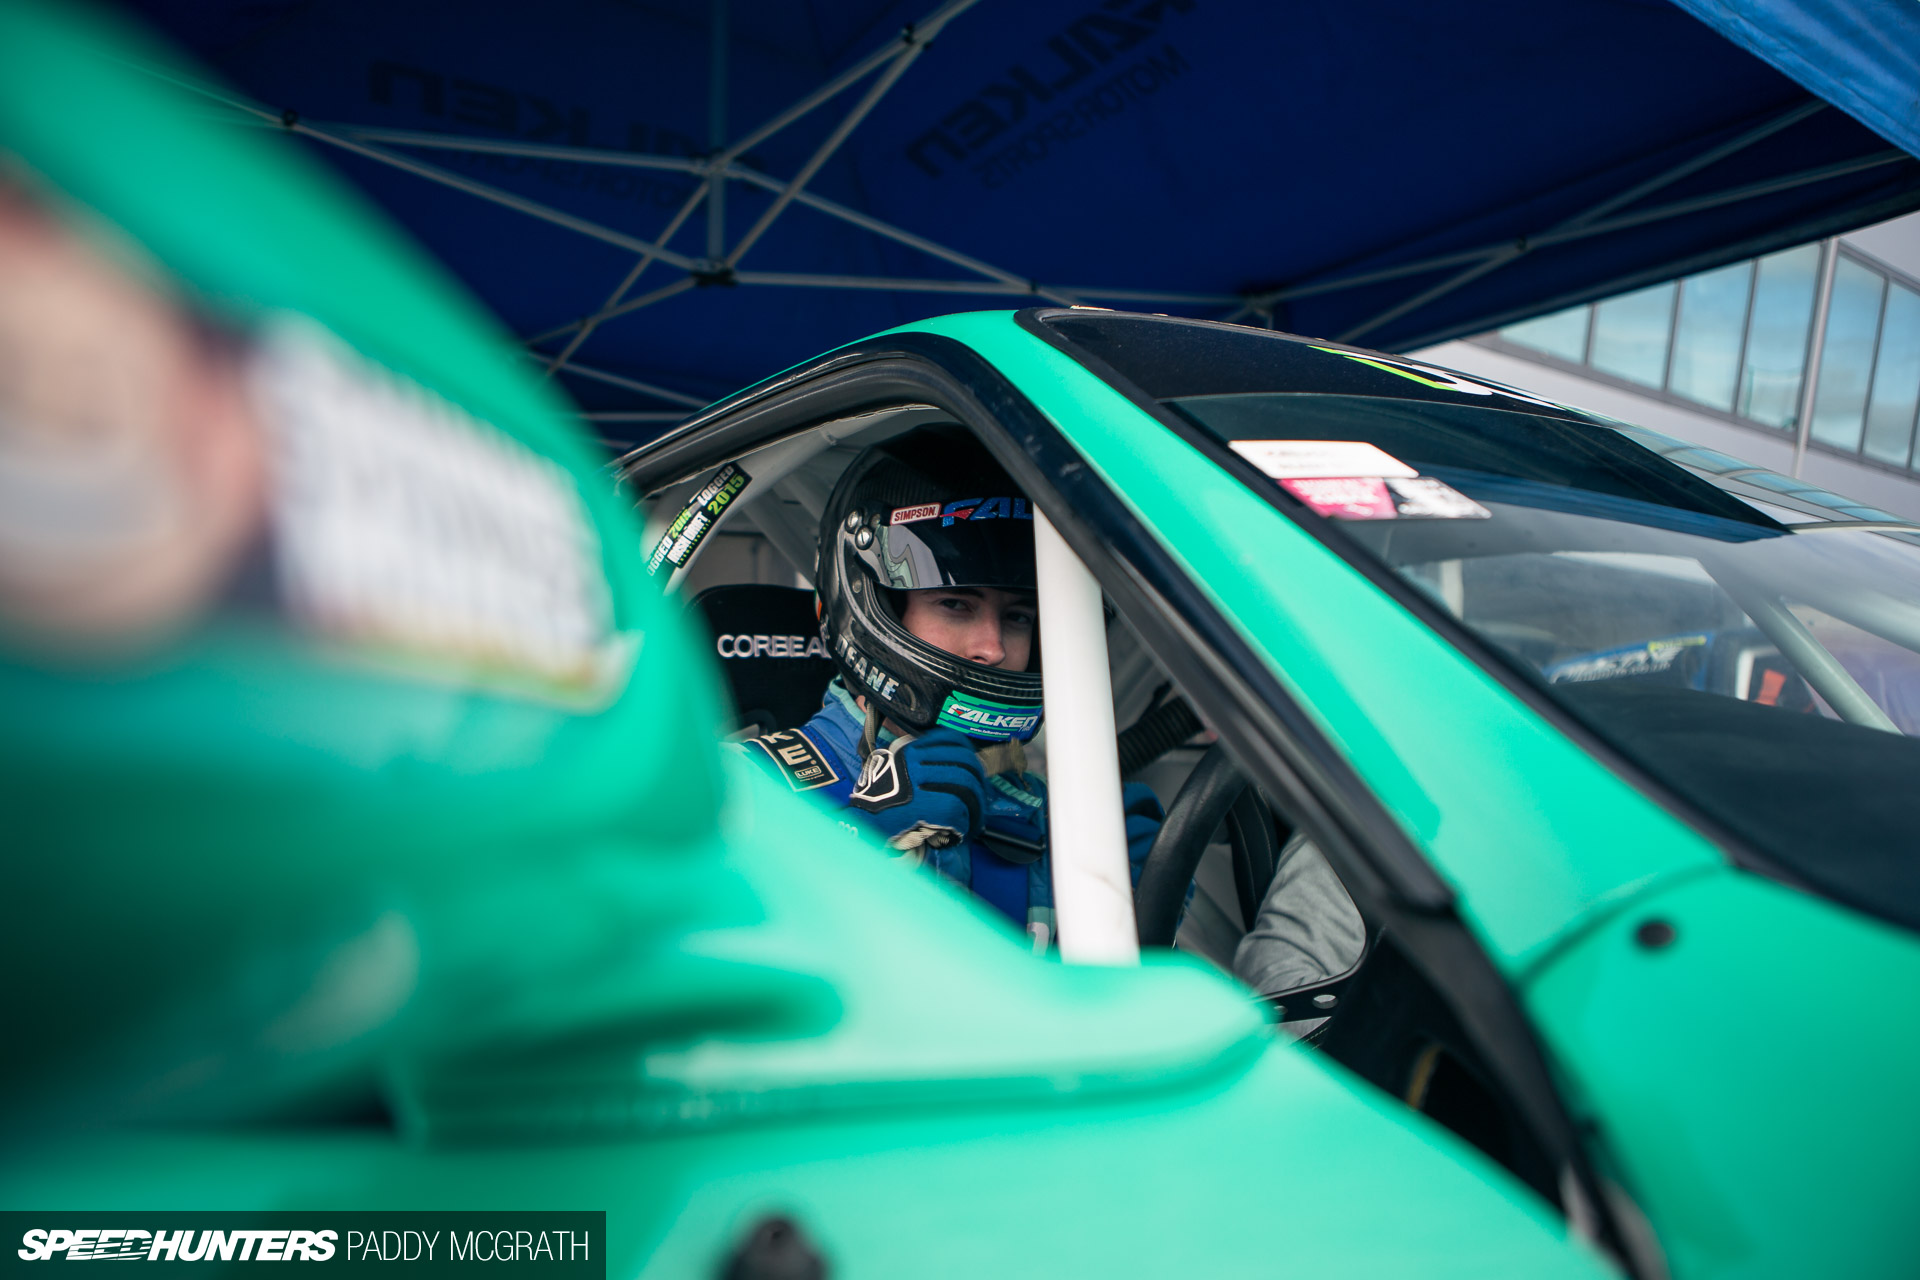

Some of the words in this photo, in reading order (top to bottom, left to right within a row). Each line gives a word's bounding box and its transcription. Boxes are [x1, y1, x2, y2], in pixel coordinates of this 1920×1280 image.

[697, 465, 734, 506] LOGGED
[707, 474, 745, 515] 2015
[942, 497, 1033, 527] FAL
[646, 535, 674, 576] OGGED
[666, 535, 692, 564] IRISH
[683, 511, 709, 541] DRIFT
[717, 634, 832, 658] CORBEA
[835, 633, 899, 701] DEANE
[947, 703, 1038, 728] FALKEN
[797, 767, 819, 777] LUKE
